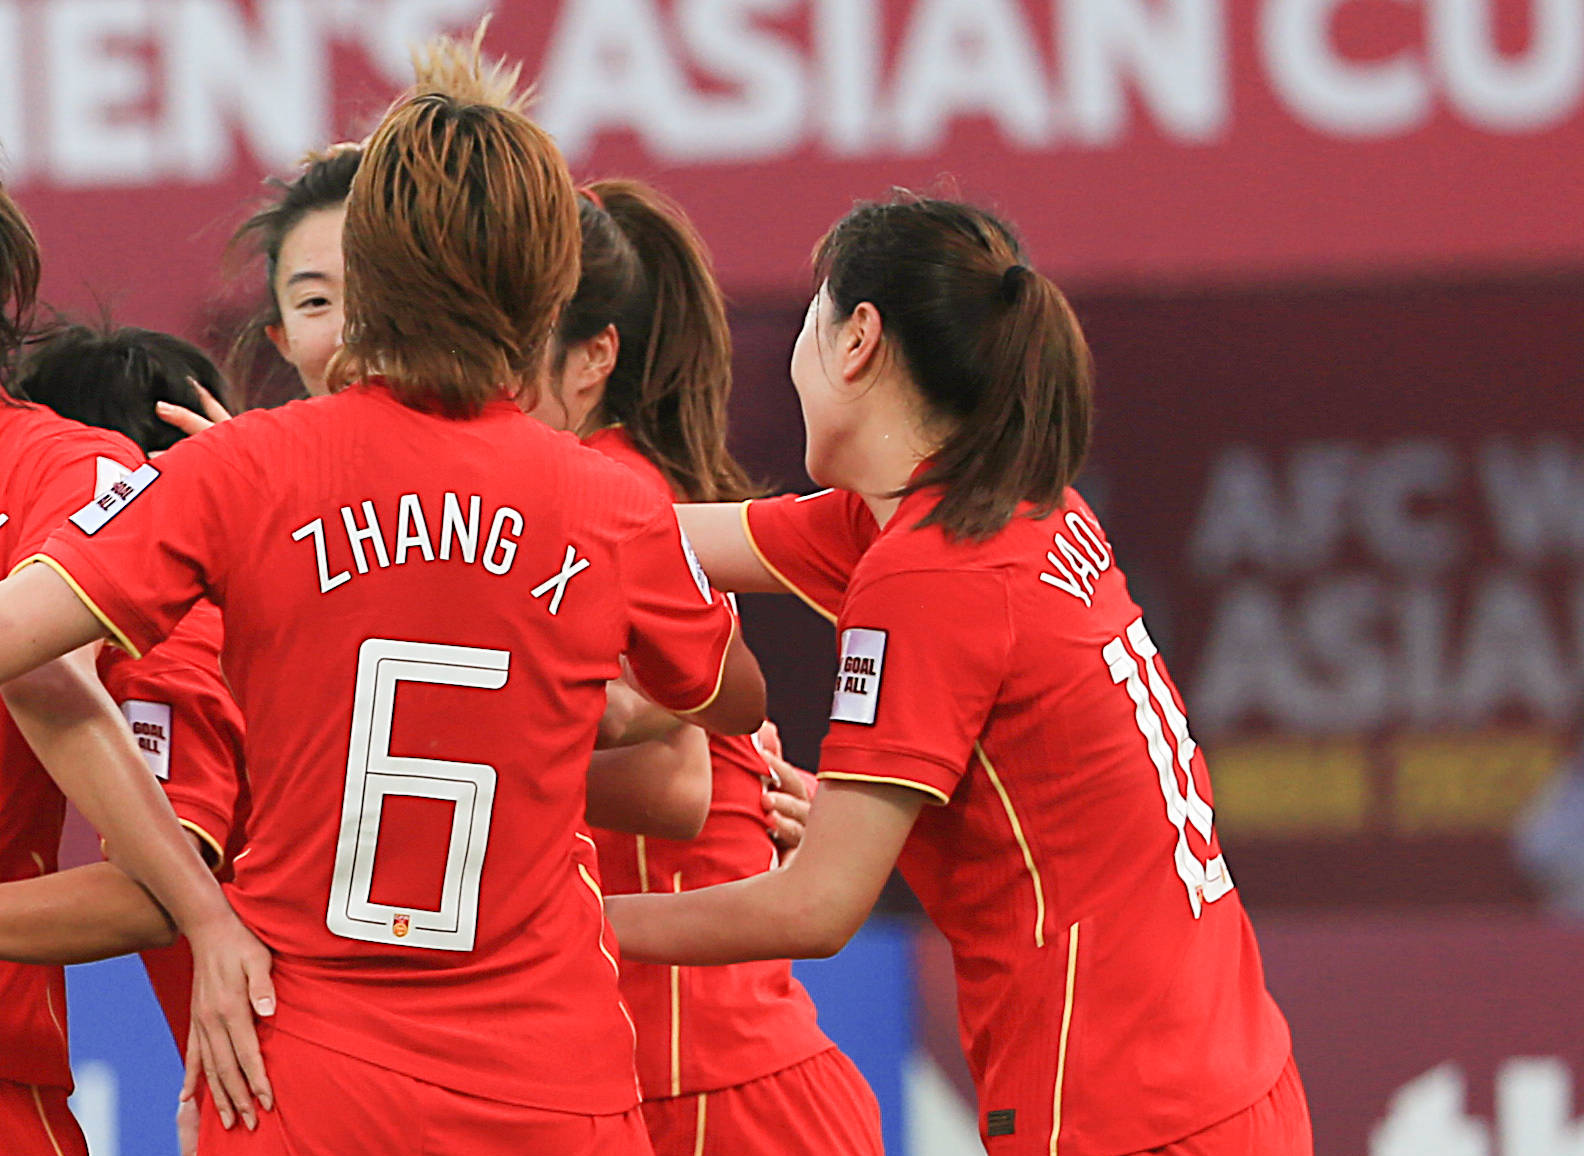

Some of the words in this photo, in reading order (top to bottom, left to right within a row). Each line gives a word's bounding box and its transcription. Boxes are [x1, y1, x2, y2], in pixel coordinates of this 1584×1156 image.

[531, 0, 1231, 168] ASIAN
[291, 492, 524, 594] ZHANG
[529, 545, 590, 616] X
[843, 676, 868, 695] ALL
[844, 656, 876, 676] GOAL
[326, 637, 511, 952] 6
